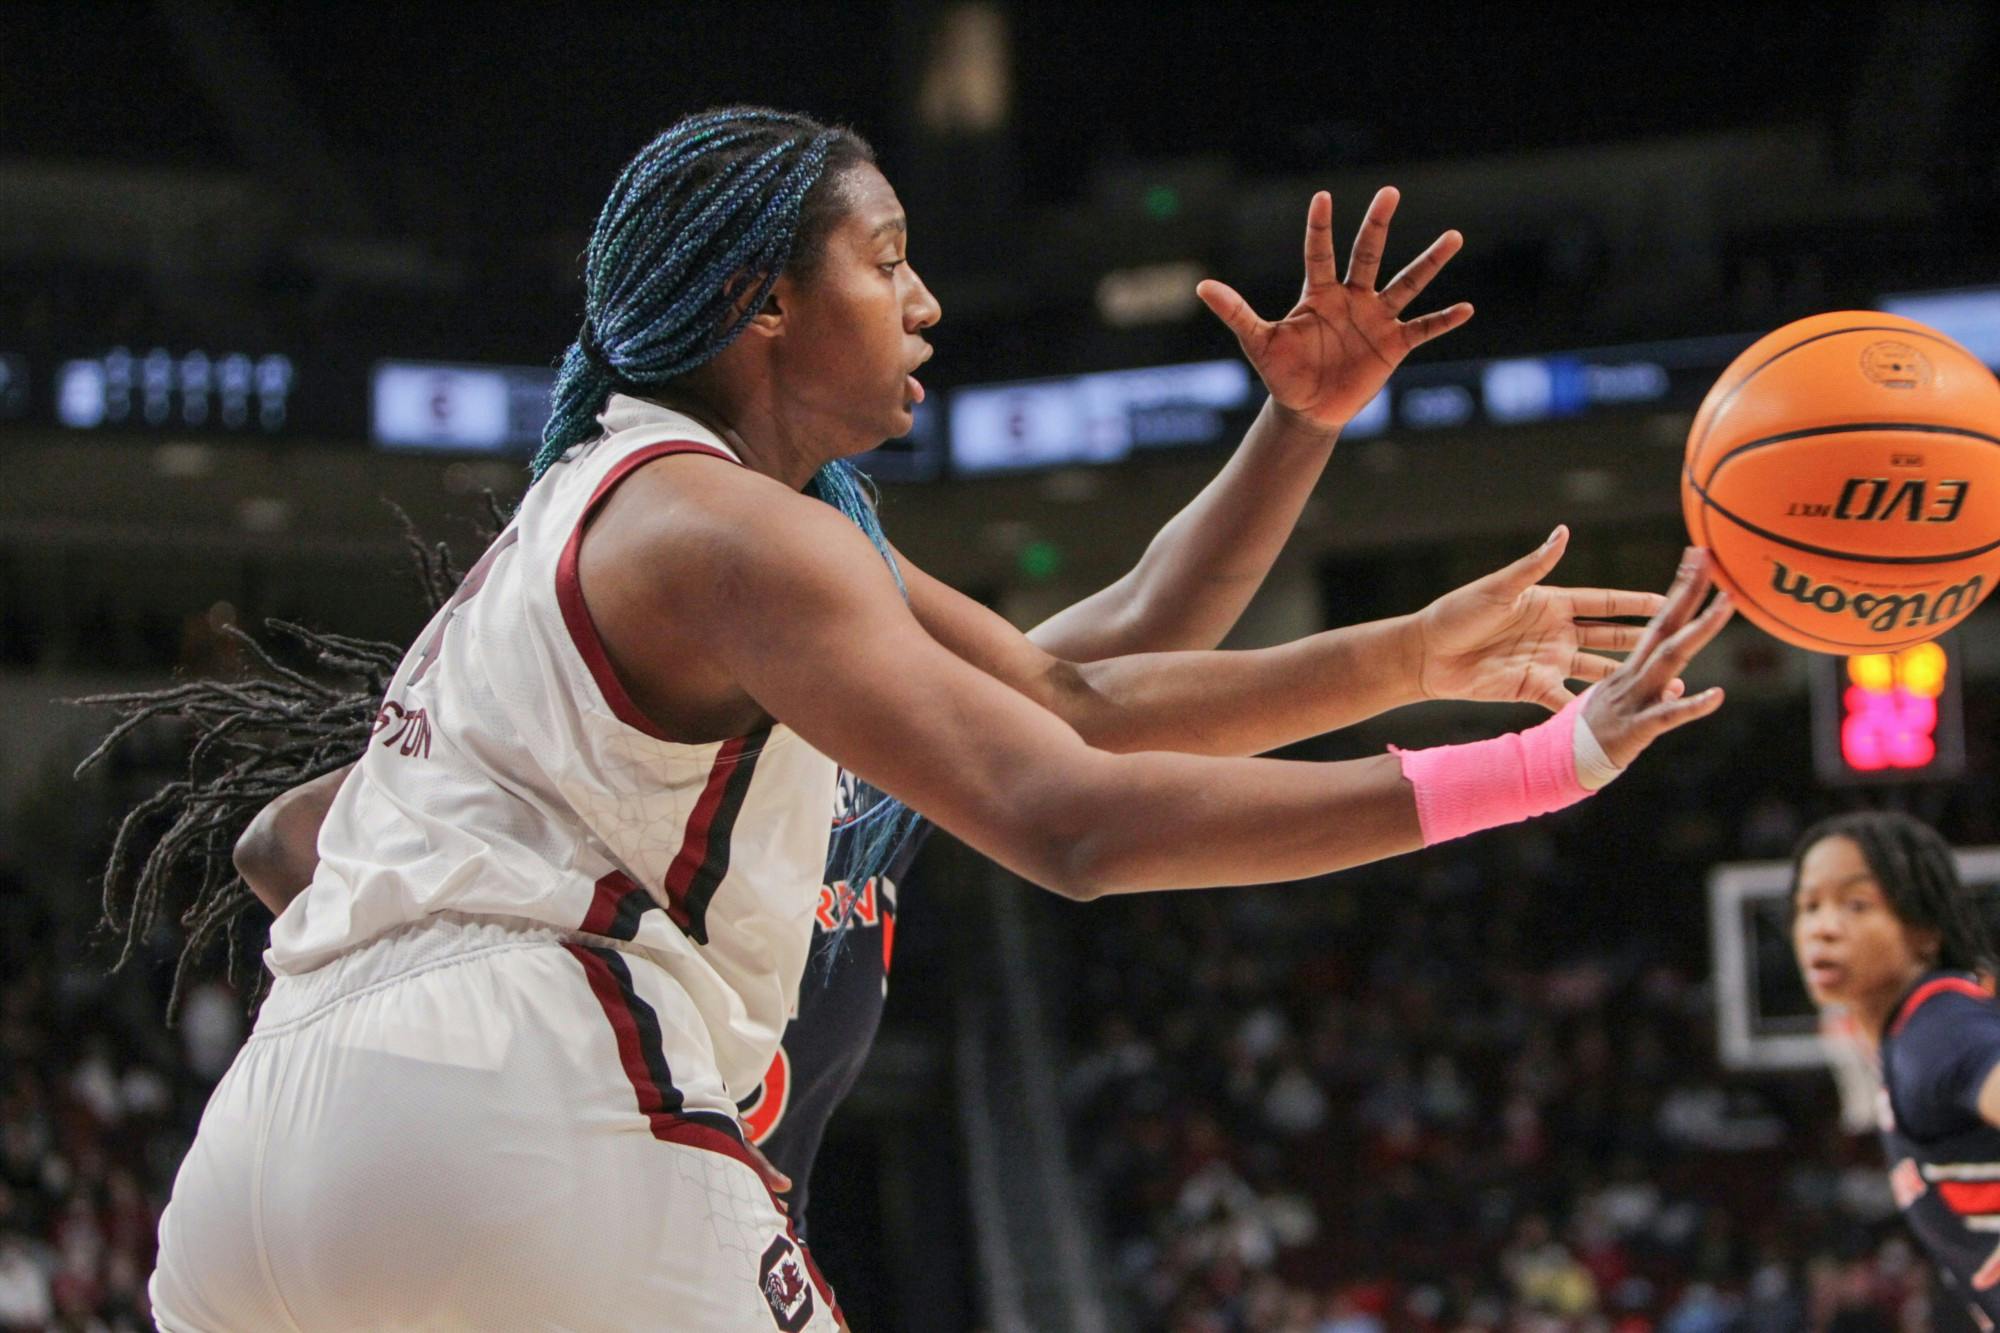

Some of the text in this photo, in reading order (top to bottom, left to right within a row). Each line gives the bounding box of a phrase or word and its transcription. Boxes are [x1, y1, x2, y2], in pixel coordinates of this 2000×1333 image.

[1786, 478, 1969, 522] EVO NXT
[1770, 560, 1984, 632] Wilson
